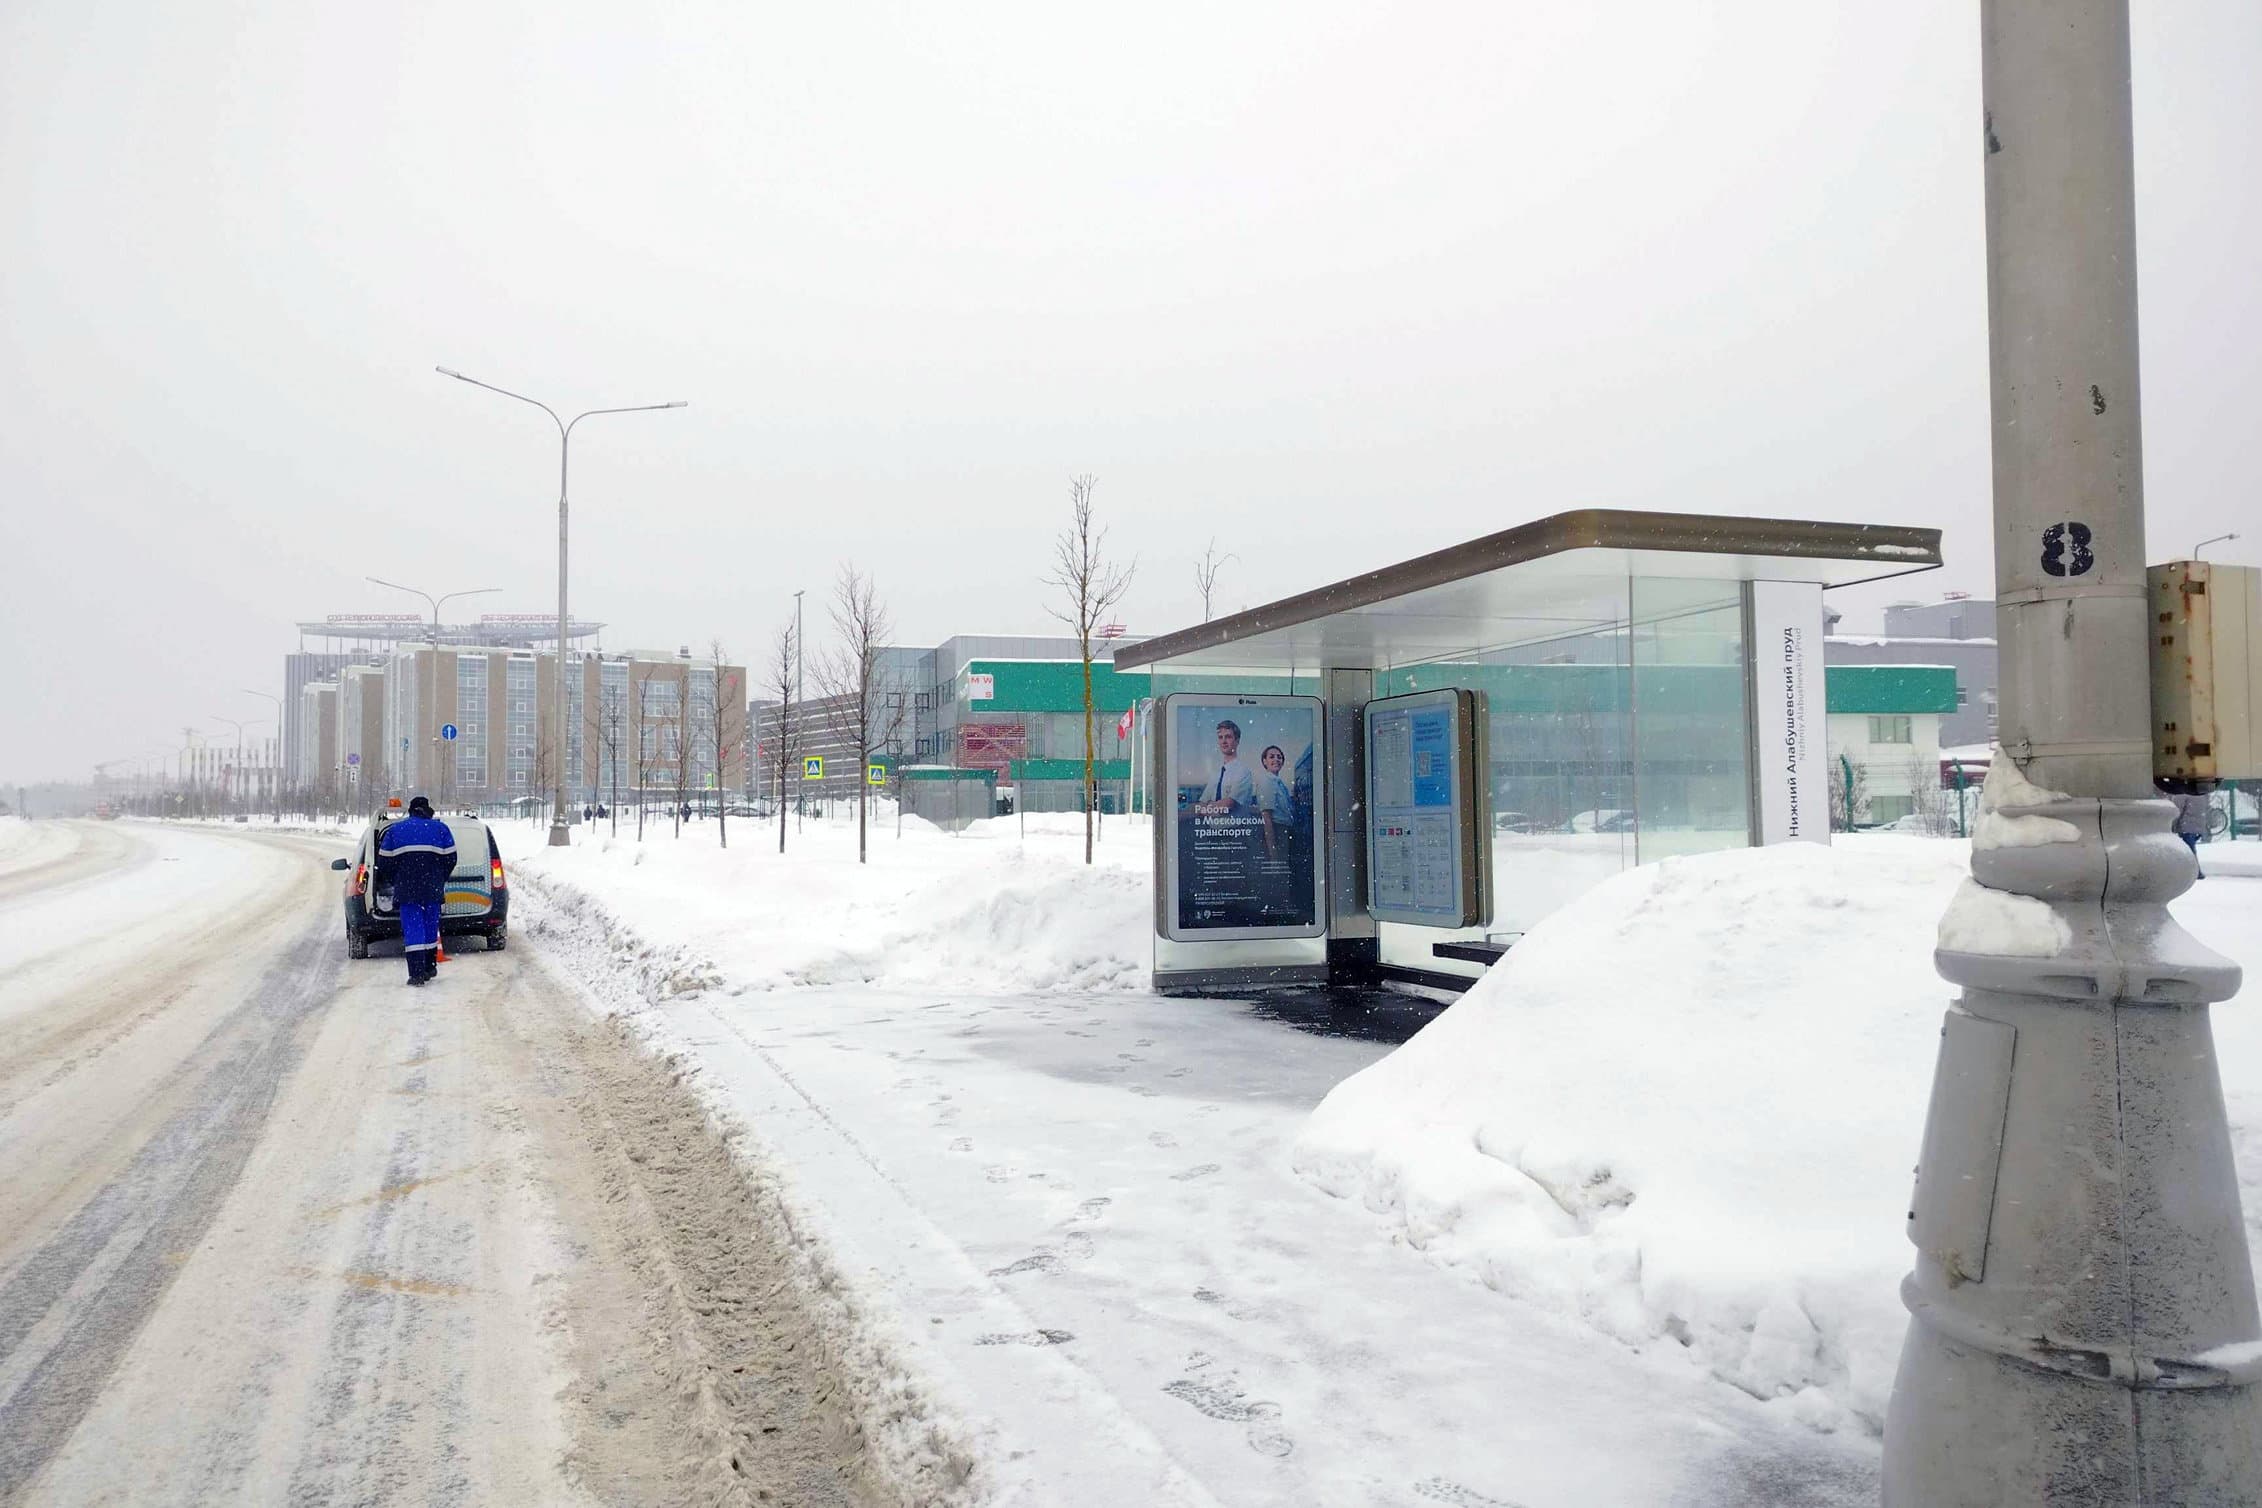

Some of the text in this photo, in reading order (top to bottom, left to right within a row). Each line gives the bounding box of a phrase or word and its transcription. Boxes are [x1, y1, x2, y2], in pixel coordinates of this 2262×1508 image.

[2041, 522, 2094, 577] 8
[1784, 627, 1799, 837] Нижний Алабушевский пруд
[1194, 804, 1230, 814] Работа
[1202, 815, 1266, 825] Московском
[1194, 828, 1252, 838] транспорте
